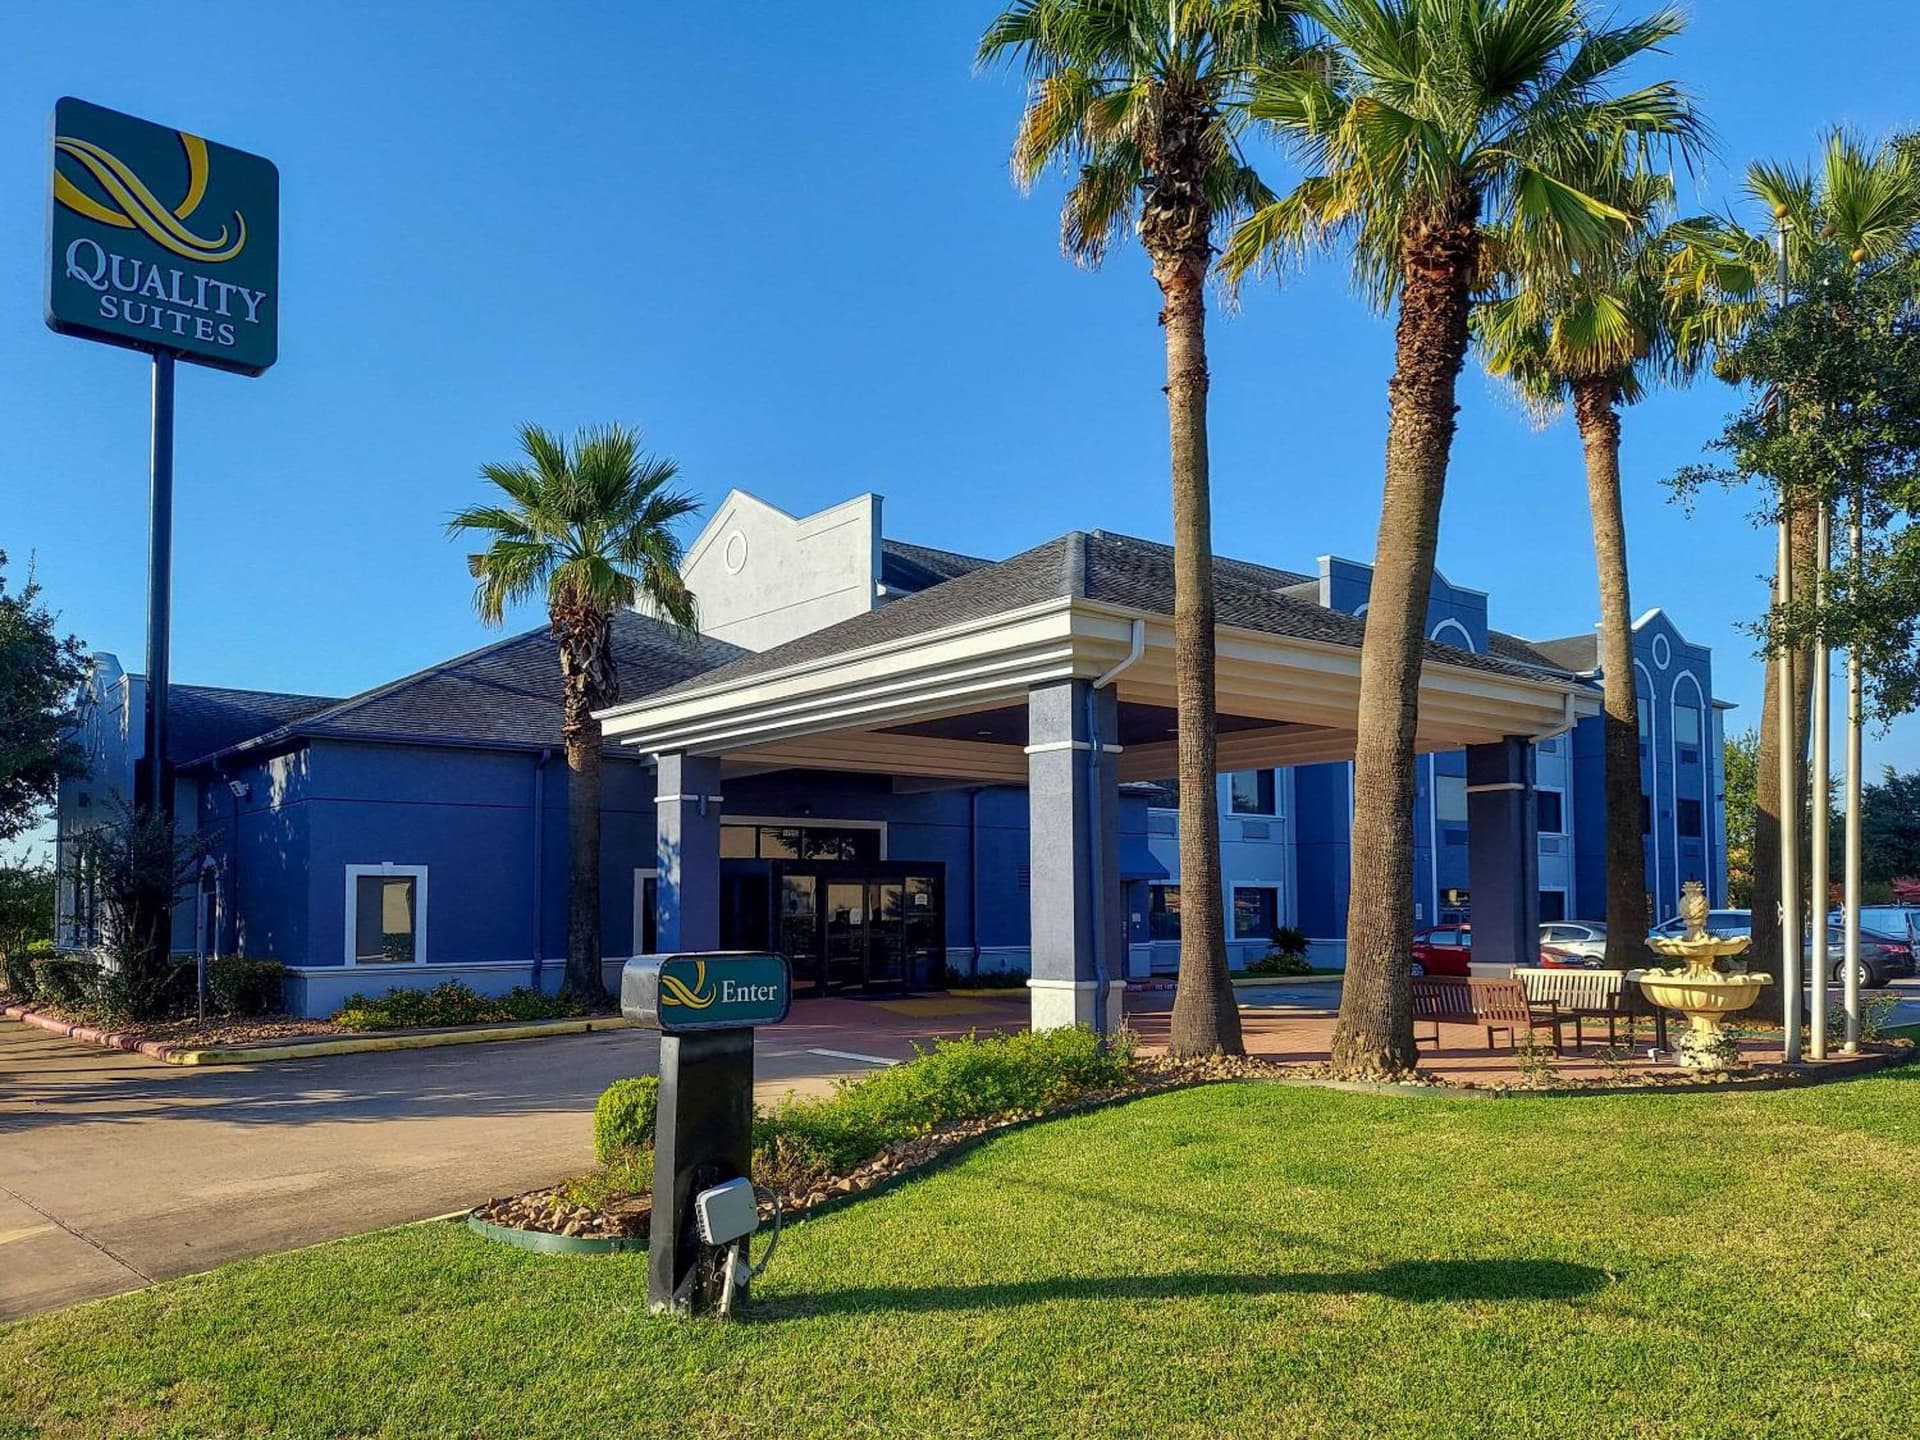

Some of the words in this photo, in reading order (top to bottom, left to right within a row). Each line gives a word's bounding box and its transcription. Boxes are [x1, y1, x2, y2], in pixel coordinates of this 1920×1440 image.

[65, 238, 267, 324] QUALITY
[100, 295, 236, 346] SUITES
[721, 980, 778, 1003] Enter
